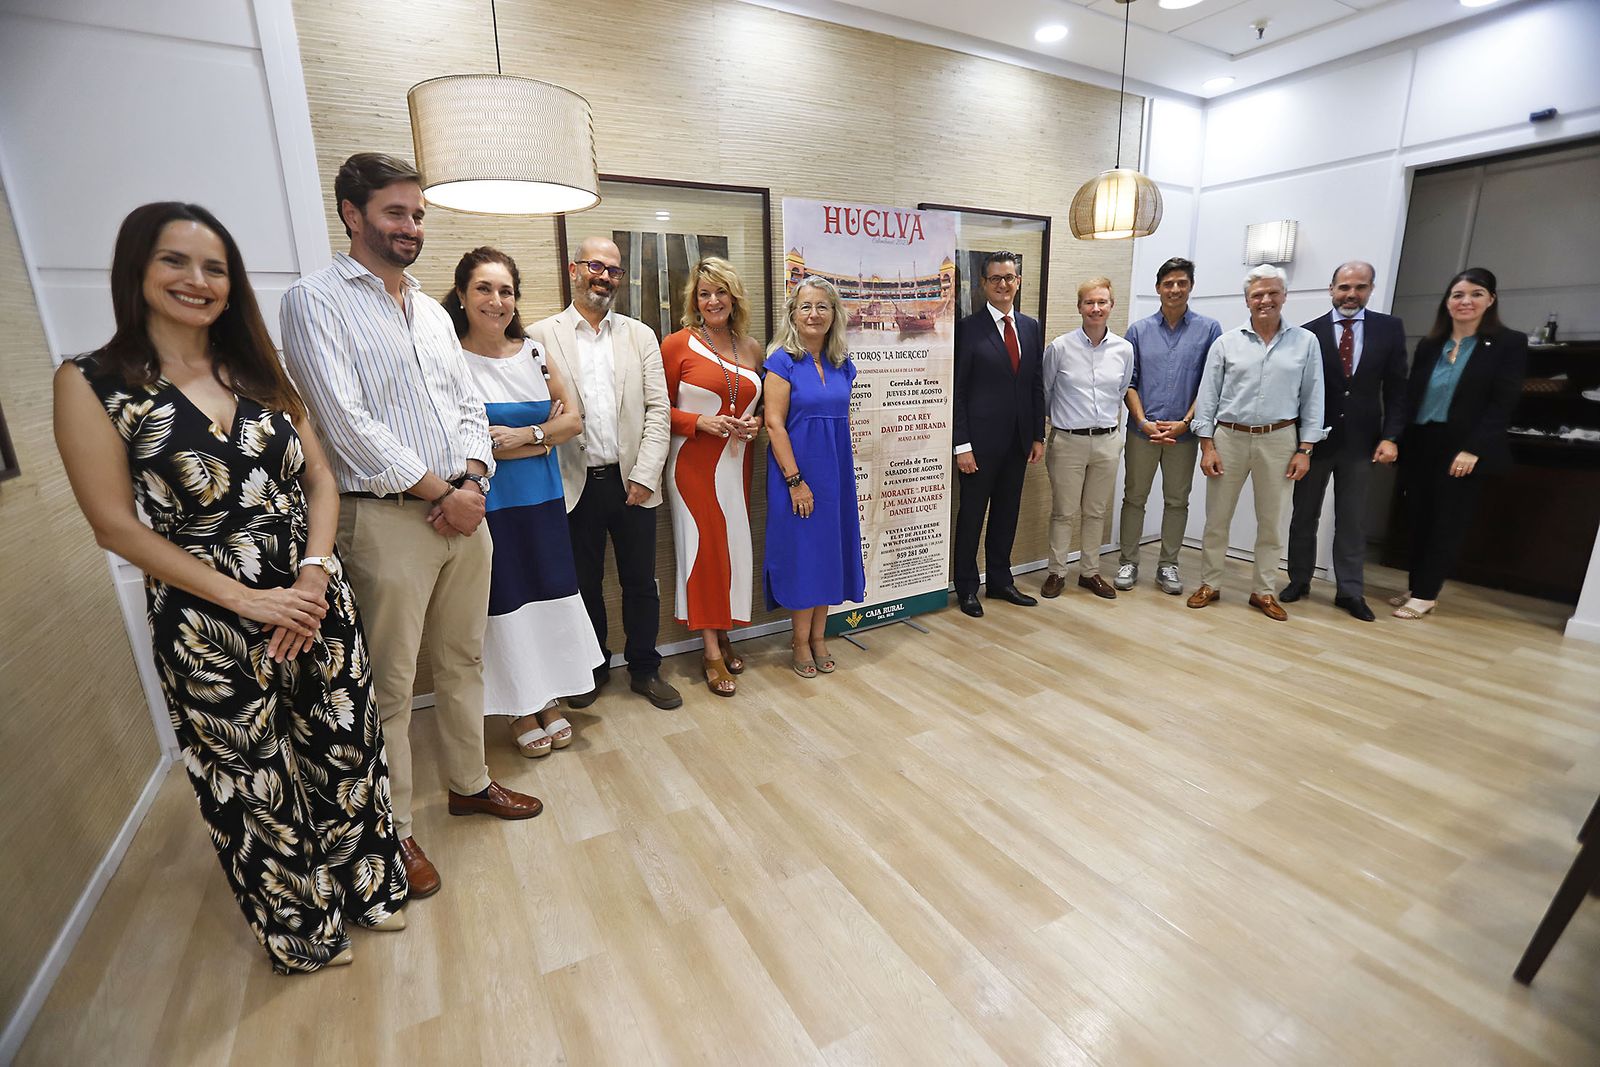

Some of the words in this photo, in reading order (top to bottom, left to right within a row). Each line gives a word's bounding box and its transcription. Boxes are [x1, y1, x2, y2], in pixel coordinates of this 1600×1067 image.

[823, 206, 925, 245] HUELVA
[856, 351, 881, 361] TOROS
[890, 379, 914, 387] Corrida
[886, 390, 907, 399] JUEVES
[898, 414, 917, 422] ROCA
[881, 425, 903, 433] DAVID
[915, 422, 946, 430] MIRANDA
[890, 459, 913, 467] Corrida
[920, 465, 943, 473] AGOSTO
[881, 487, 915, 499] MORANTE
[920, 484, 945, 493] PUEBLA
[883, 501, 896, 510] J.M.
[896, 494, 943, 506] MANZANARES
[889, 506, 914, 516] DANIEL
[915, 504, 938, 513] LUQUE
[896, 551, 907, 559] 959
[907, 549, 917, 557] 281
[918, 547, 929, 555] 500
[882, 603, 905, 614] RURAL
